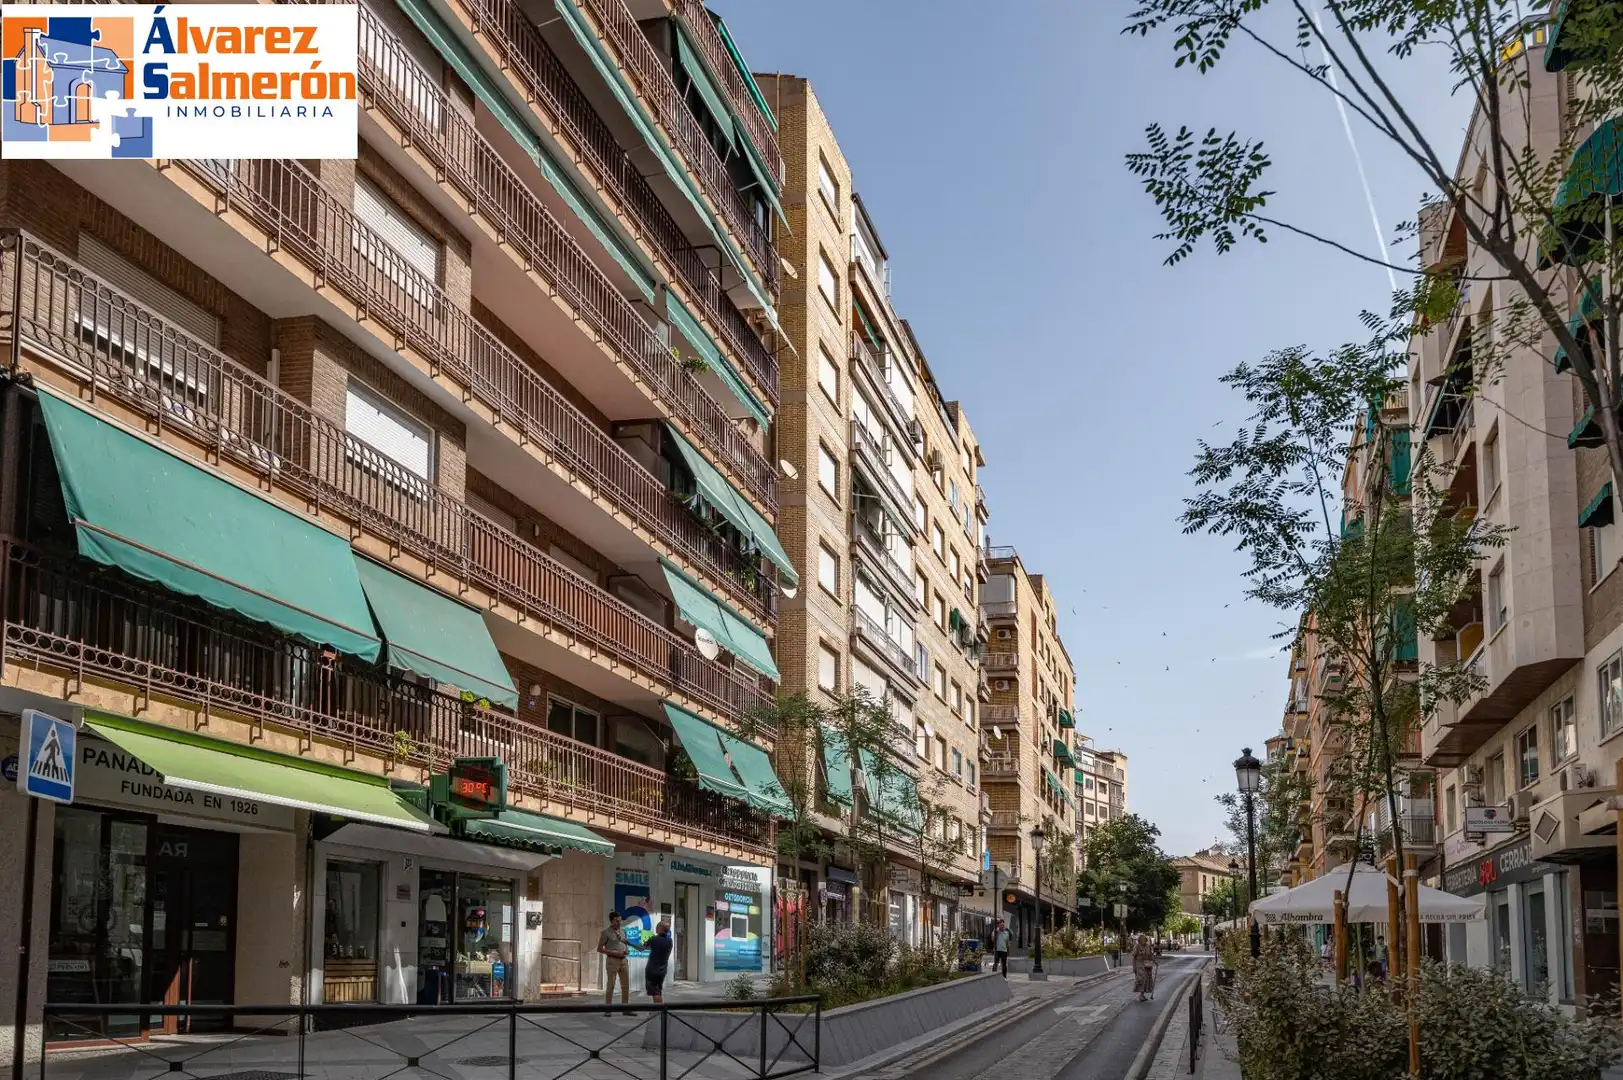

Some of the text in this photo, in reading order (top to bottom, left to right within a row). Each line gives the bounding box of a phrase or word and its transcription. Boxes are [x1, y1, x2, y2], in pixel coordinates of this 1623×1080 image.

[121, 780, 258, 815] FUNDADA EN 1926
[1500, 844, 1534, 874] CERRAJE
[1279, 912, 1323, 922] Alhambra
